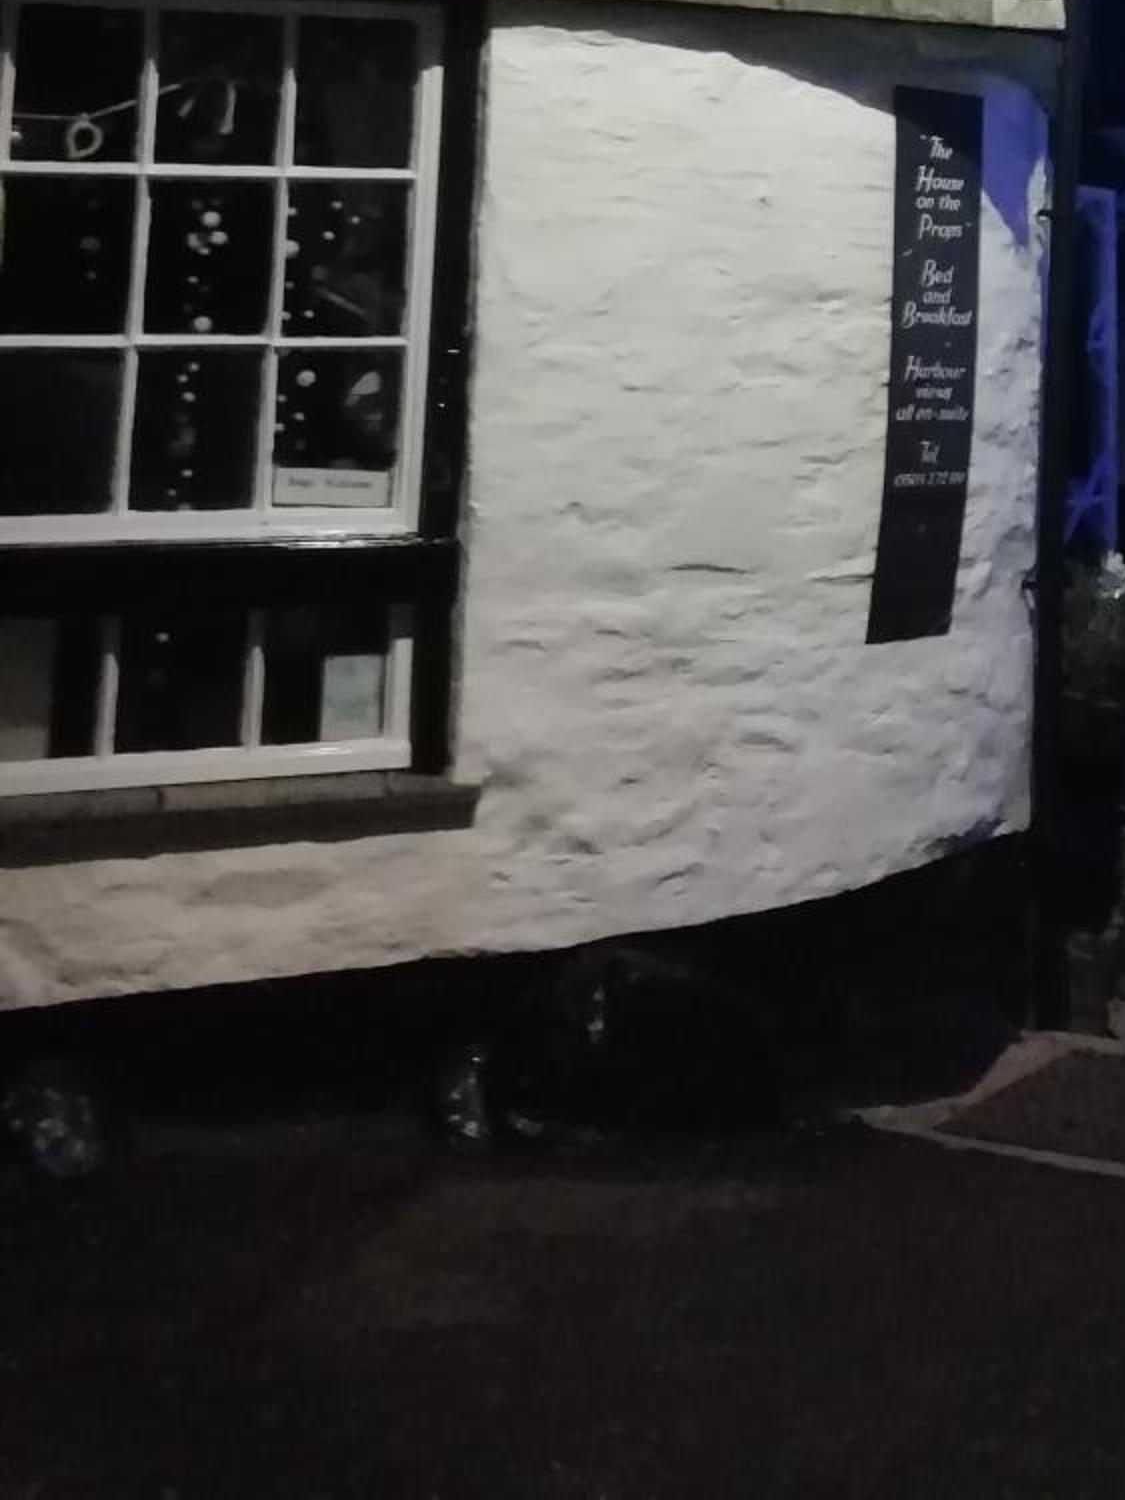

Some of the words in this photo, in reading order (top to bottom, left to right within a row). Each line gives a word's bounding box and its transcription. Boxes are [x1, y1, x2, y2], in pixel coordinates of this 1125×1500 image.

[915, 165, 965, 192] House
[915, 195, 935, 210] on
[939, 193, 961, 211] the
[921, 259, 954, 287] Bed
[923, 289, 952, 305] and
[901, 301, 973, 329] Breakfast
